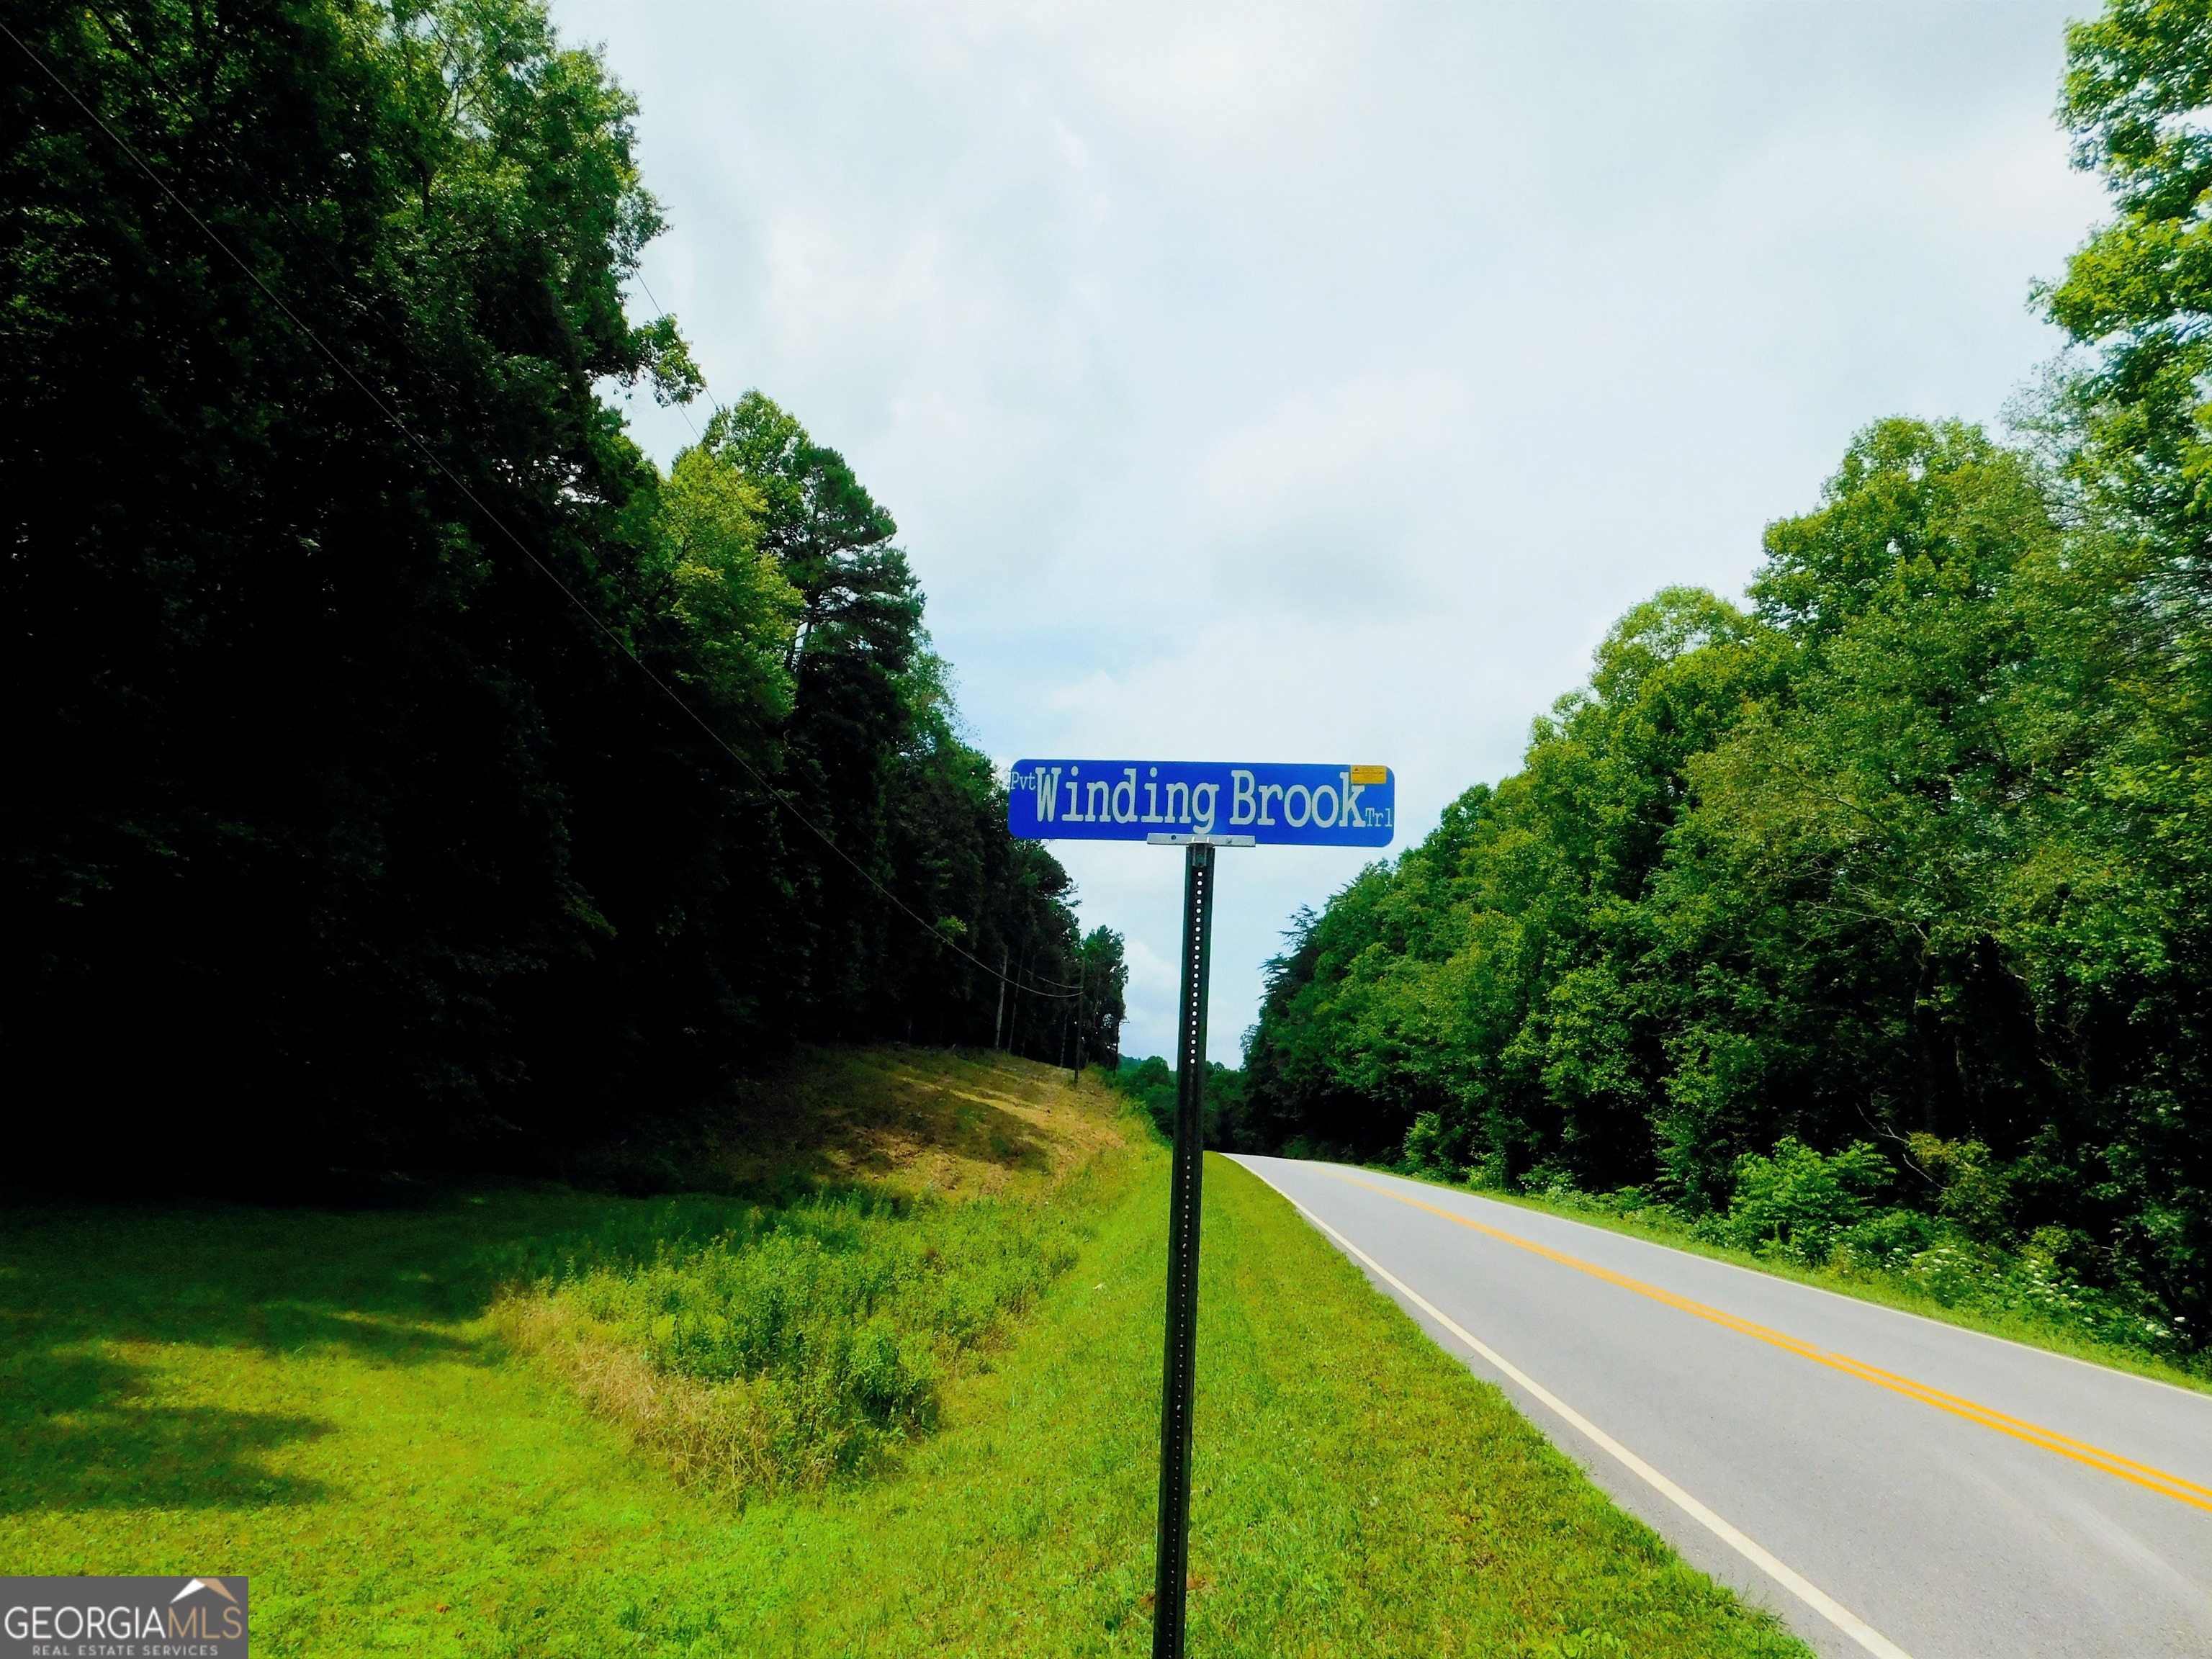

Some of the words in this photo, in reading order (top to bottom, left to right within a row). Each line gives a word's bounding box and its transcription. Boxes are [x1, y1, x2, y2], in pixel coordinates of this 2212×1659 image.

[1010, 770, 1036, 791] Pvt
[1035, 767, 1220, 834] Winding
[1230, 770, 1365, 828] Brook
